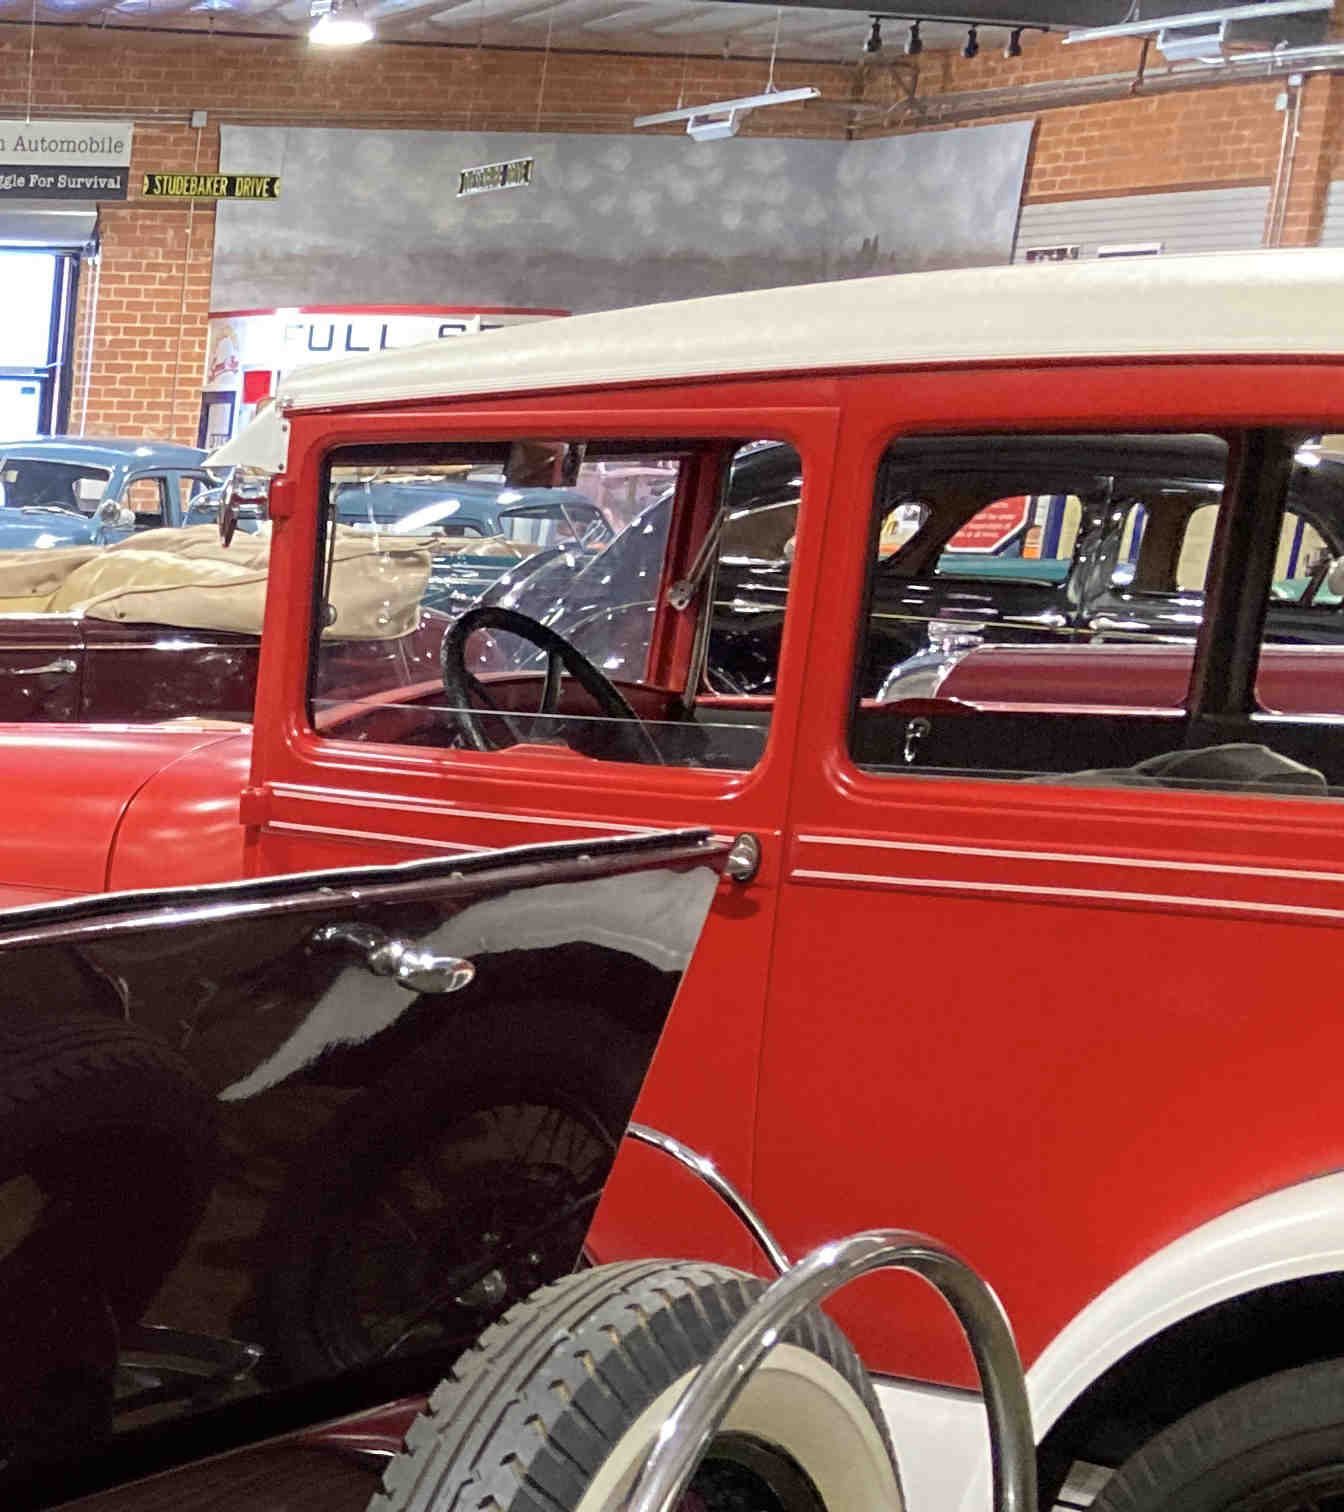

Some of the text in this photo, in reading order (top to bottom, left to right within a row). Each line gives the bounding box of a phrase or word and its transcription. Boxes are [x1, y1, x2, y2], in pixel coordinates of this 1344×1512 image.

[13, 133, 125, 155] Automobile
[29, 174, 55, 188] For
[58, 174, 121, 189] Survival
[153, 175, 270, 198] STUDEBAKER DRIVE
